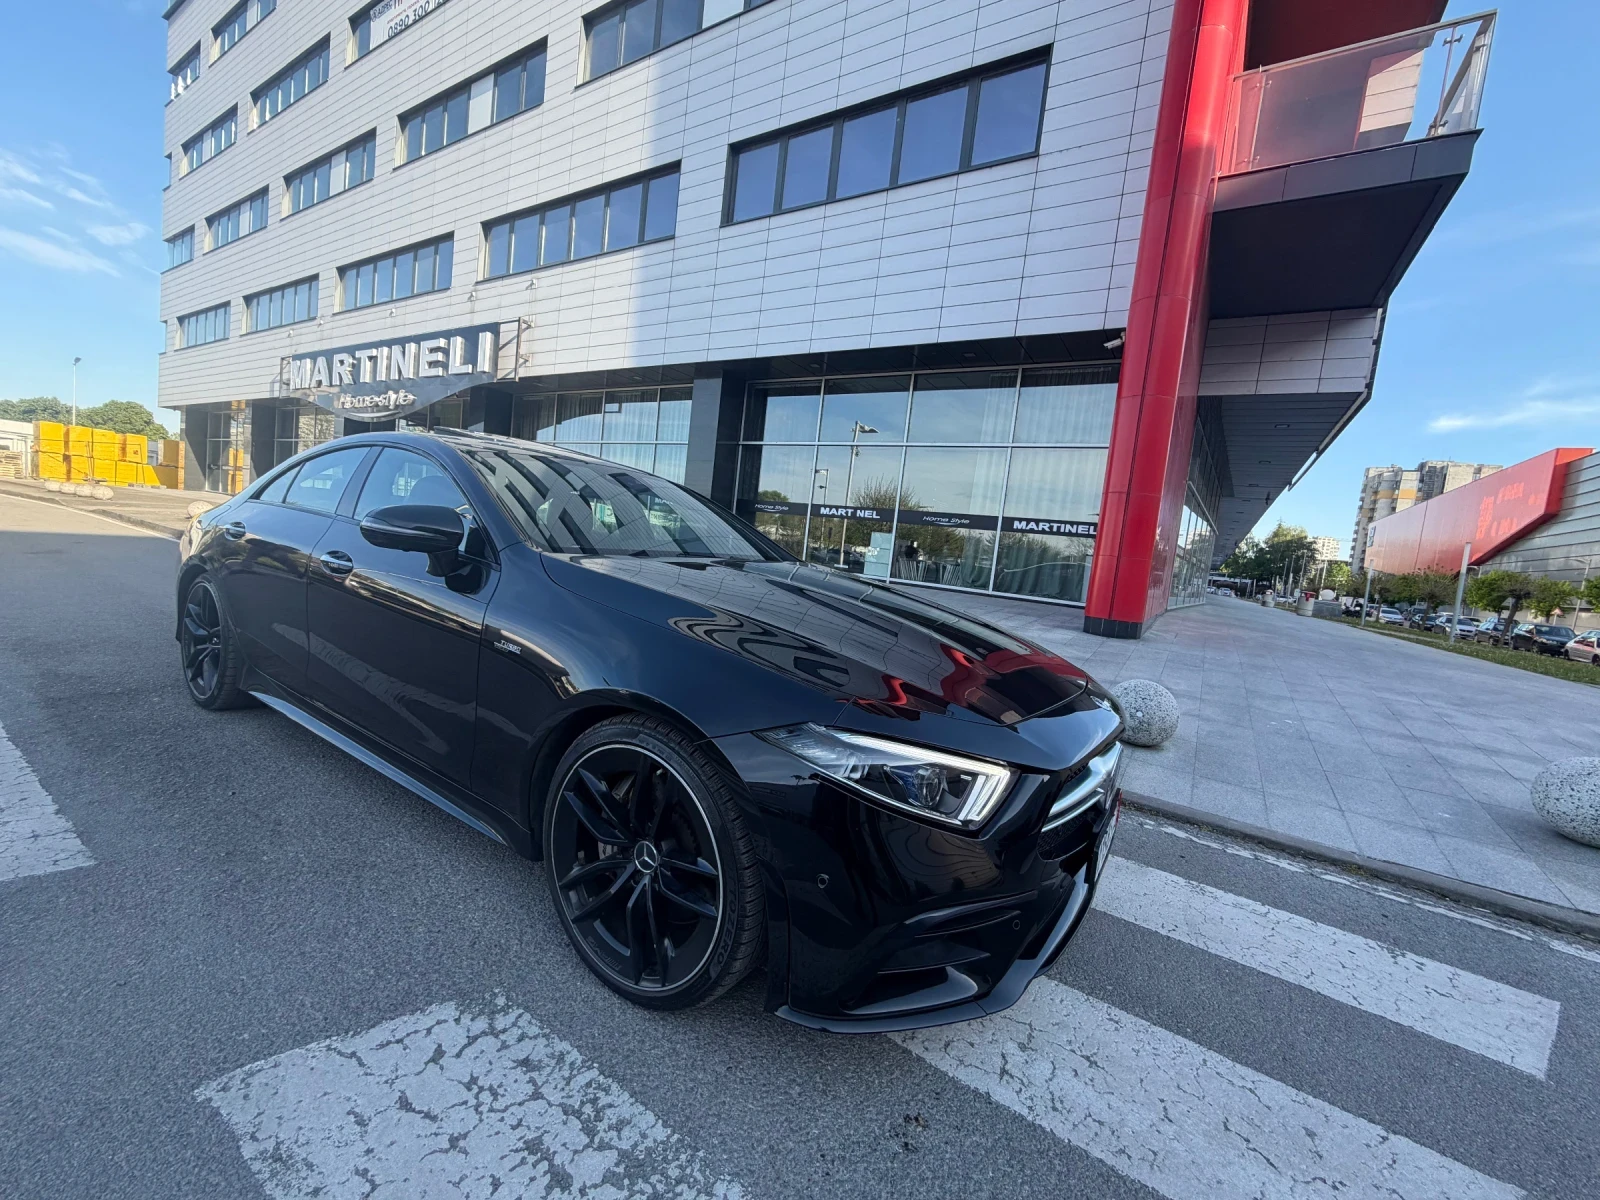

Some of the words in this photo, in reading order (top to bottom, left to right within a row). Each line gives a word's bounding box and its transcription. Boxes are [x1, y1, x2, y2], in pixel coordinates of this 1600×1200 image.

[387, 14, 409, 38] 0890
[412, 0, 430, 21] 300
[290, 331, 494, 390] MARTINELI
[338, 393, 377, 409] Home
[1013, 520, 1098, 536] MARTINEL
